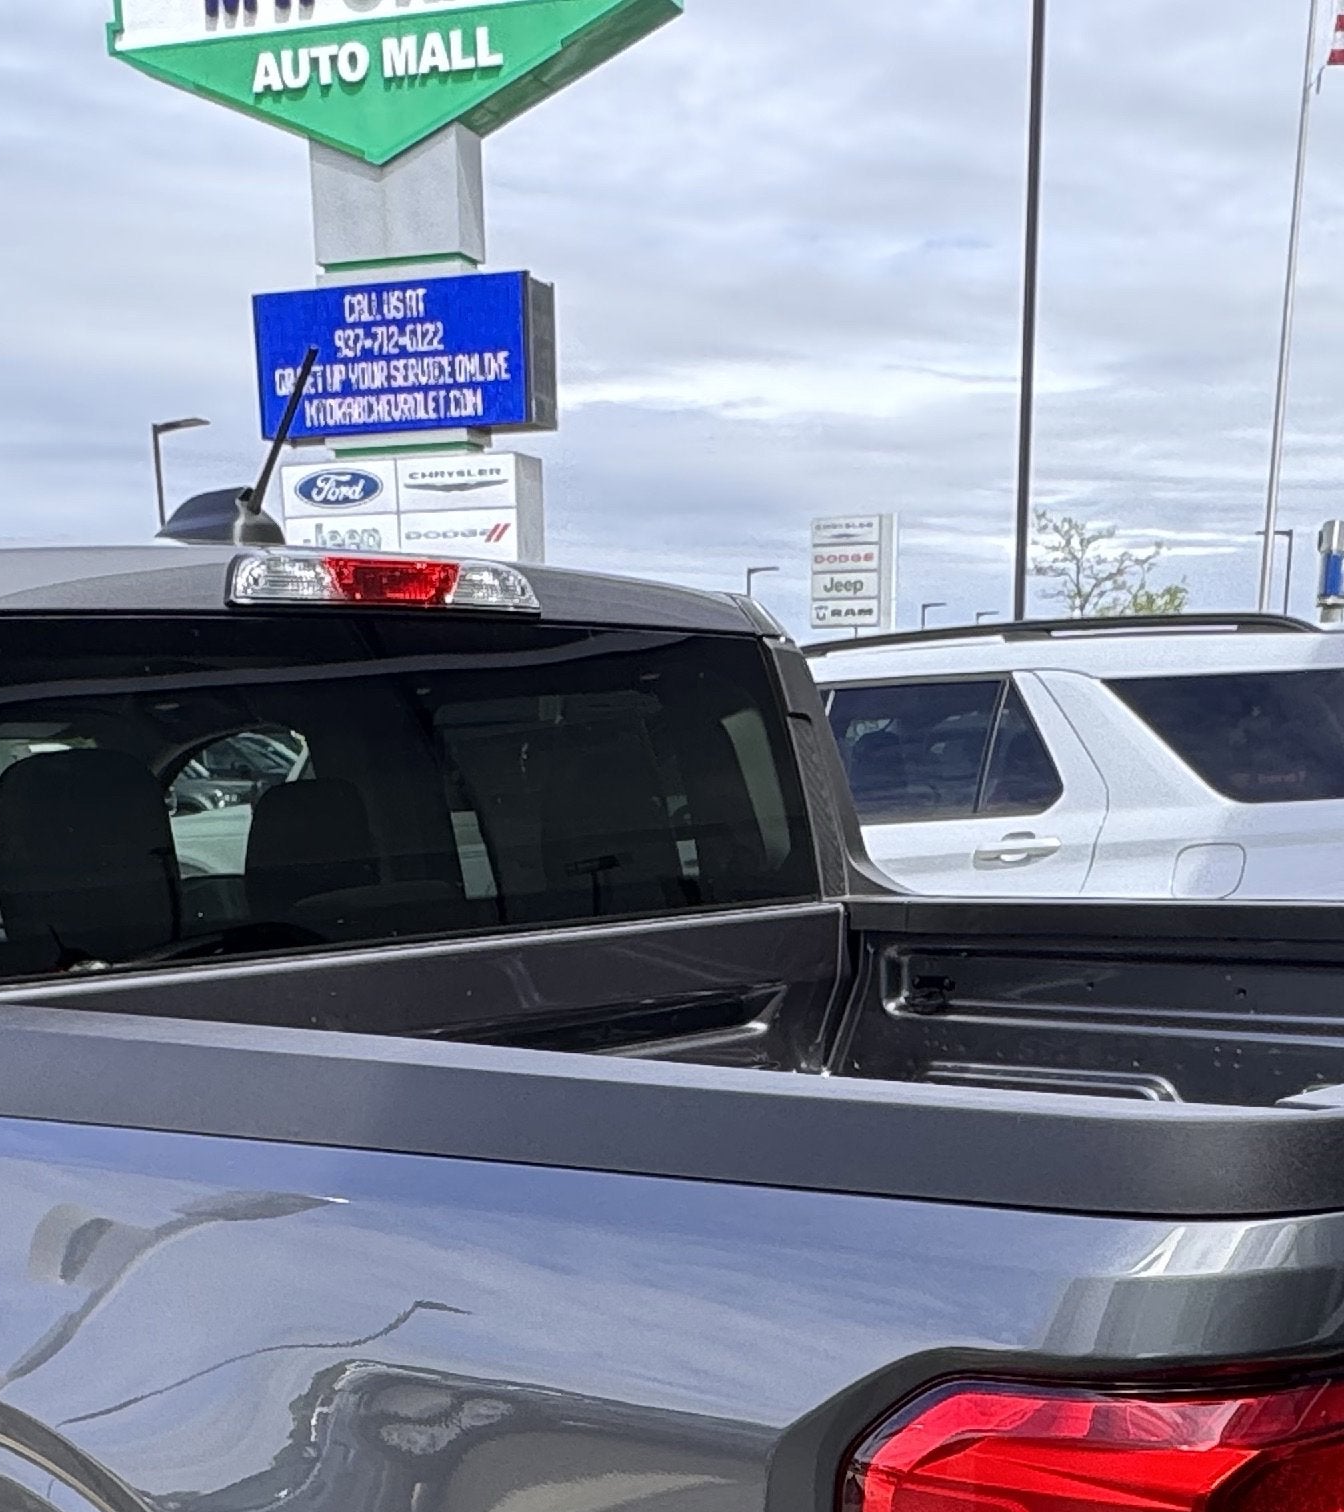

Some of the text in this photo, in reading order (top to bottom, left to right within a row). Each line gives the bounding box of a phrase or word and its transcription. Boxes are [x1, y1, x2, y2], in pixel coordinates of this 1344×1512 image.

[251, 26, 504, 95] AUTO MALL
[343, 287, 428, 324] CALL US AT
[334, 320, 445, 358] 937-712-6122
[325, 363, 346, 394] UP
[348, 359, 389, 392] YOUR
[390, 354, 453, 389] SERVICE
[454, 350, 511, 385] ONLINE
[310, 473, 364, 502] Ford
[408, 468, 502, 480] CHRYSLER
[813, 552, 874, 565] DODGE
[822, 576, 864, 595] Jeep
[830, 607, 874, 617] RAM
